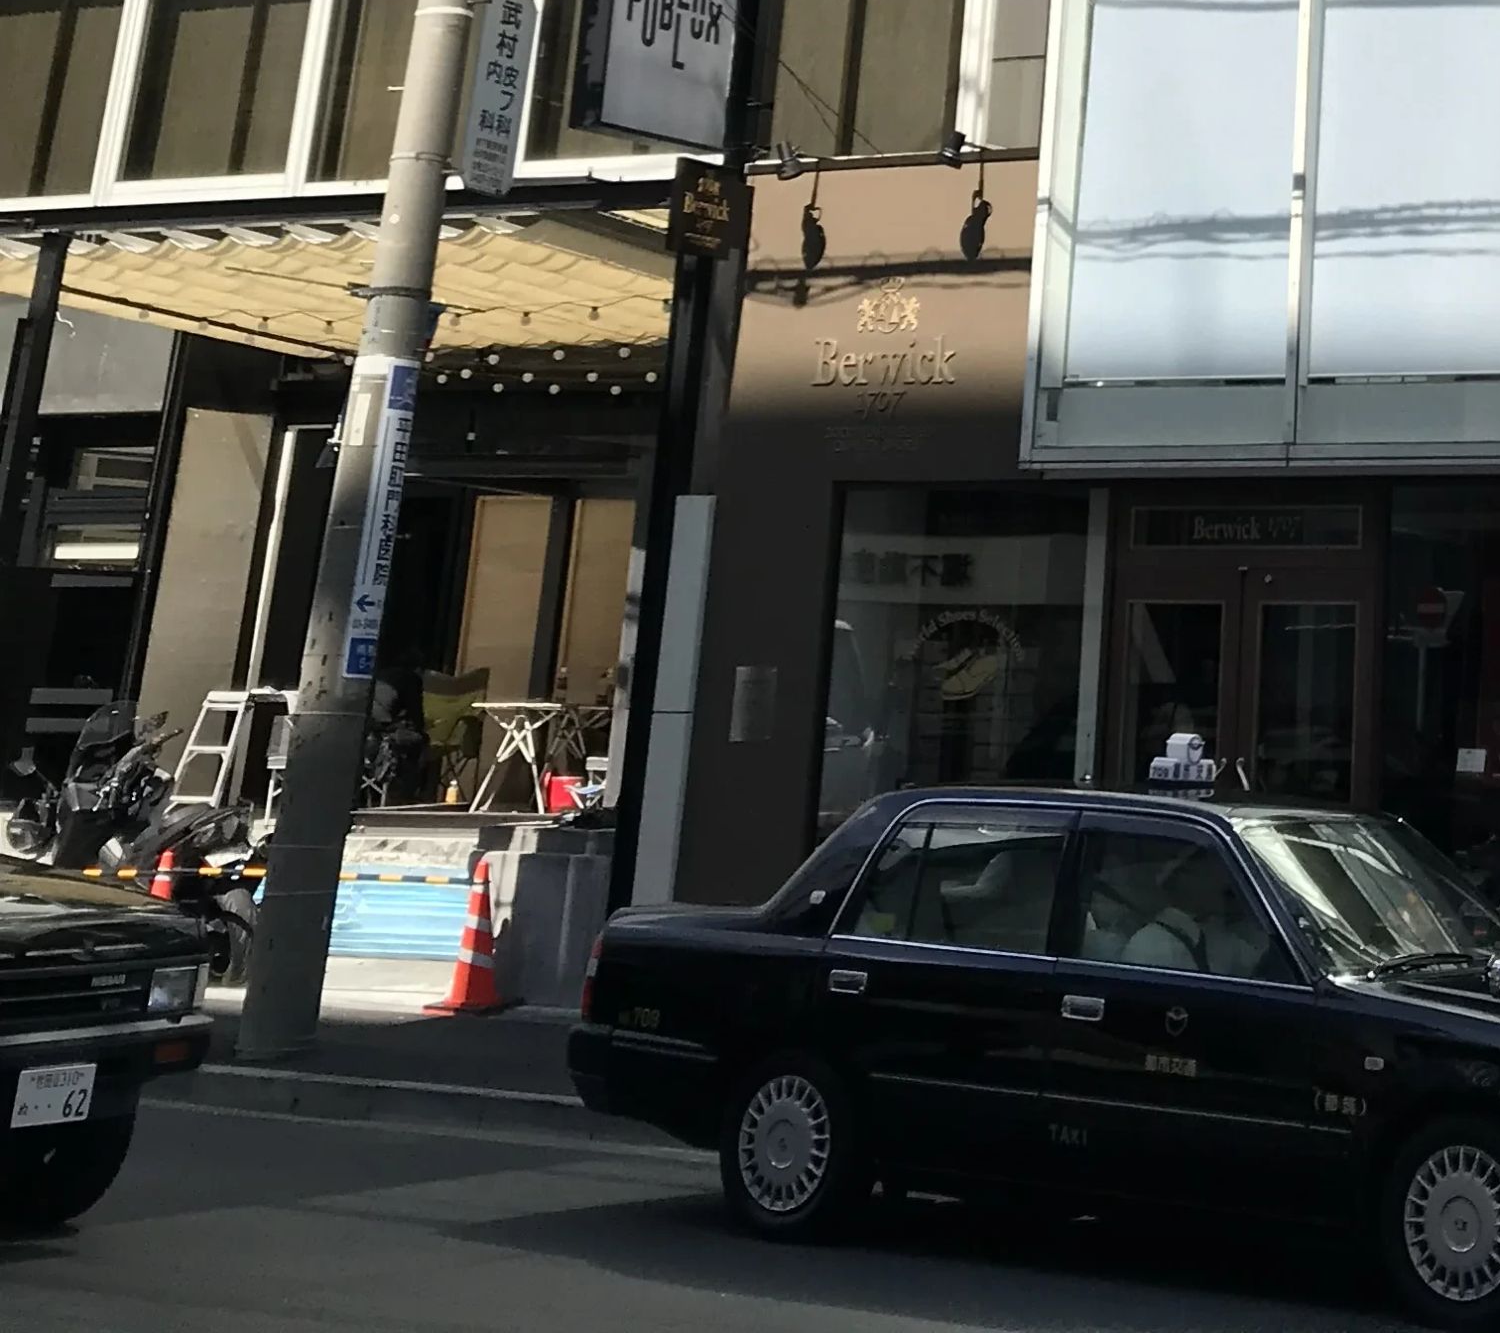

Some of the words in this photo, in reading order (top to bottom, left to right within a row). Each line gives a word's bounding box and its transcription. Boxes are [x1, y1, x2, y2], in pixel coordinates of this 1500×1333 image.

[810, 335, 957, 387] Berwick
[1192, 515, 1261, 540] Berwick
[62, 1088, 89, 1118] 62
